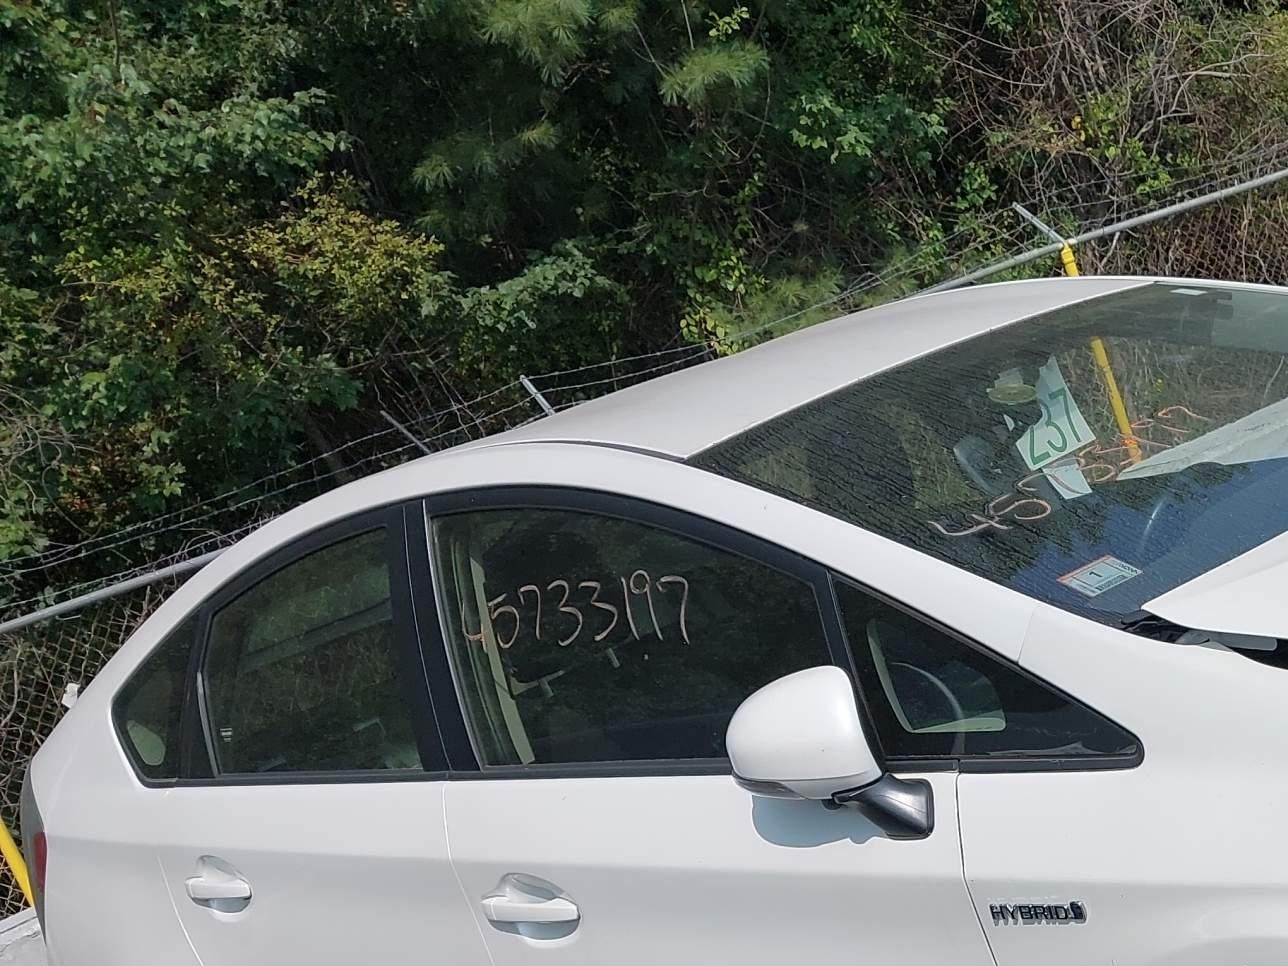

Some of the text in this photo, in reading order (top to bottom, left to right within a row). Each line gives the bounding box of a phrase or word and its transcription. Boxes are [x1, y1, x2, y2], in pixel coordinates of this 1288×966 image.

[1029, 387, 1082, 466] 237
[461, 568, 690, 649] 45733197
[988, 902, 1069, 926] HYBRID
